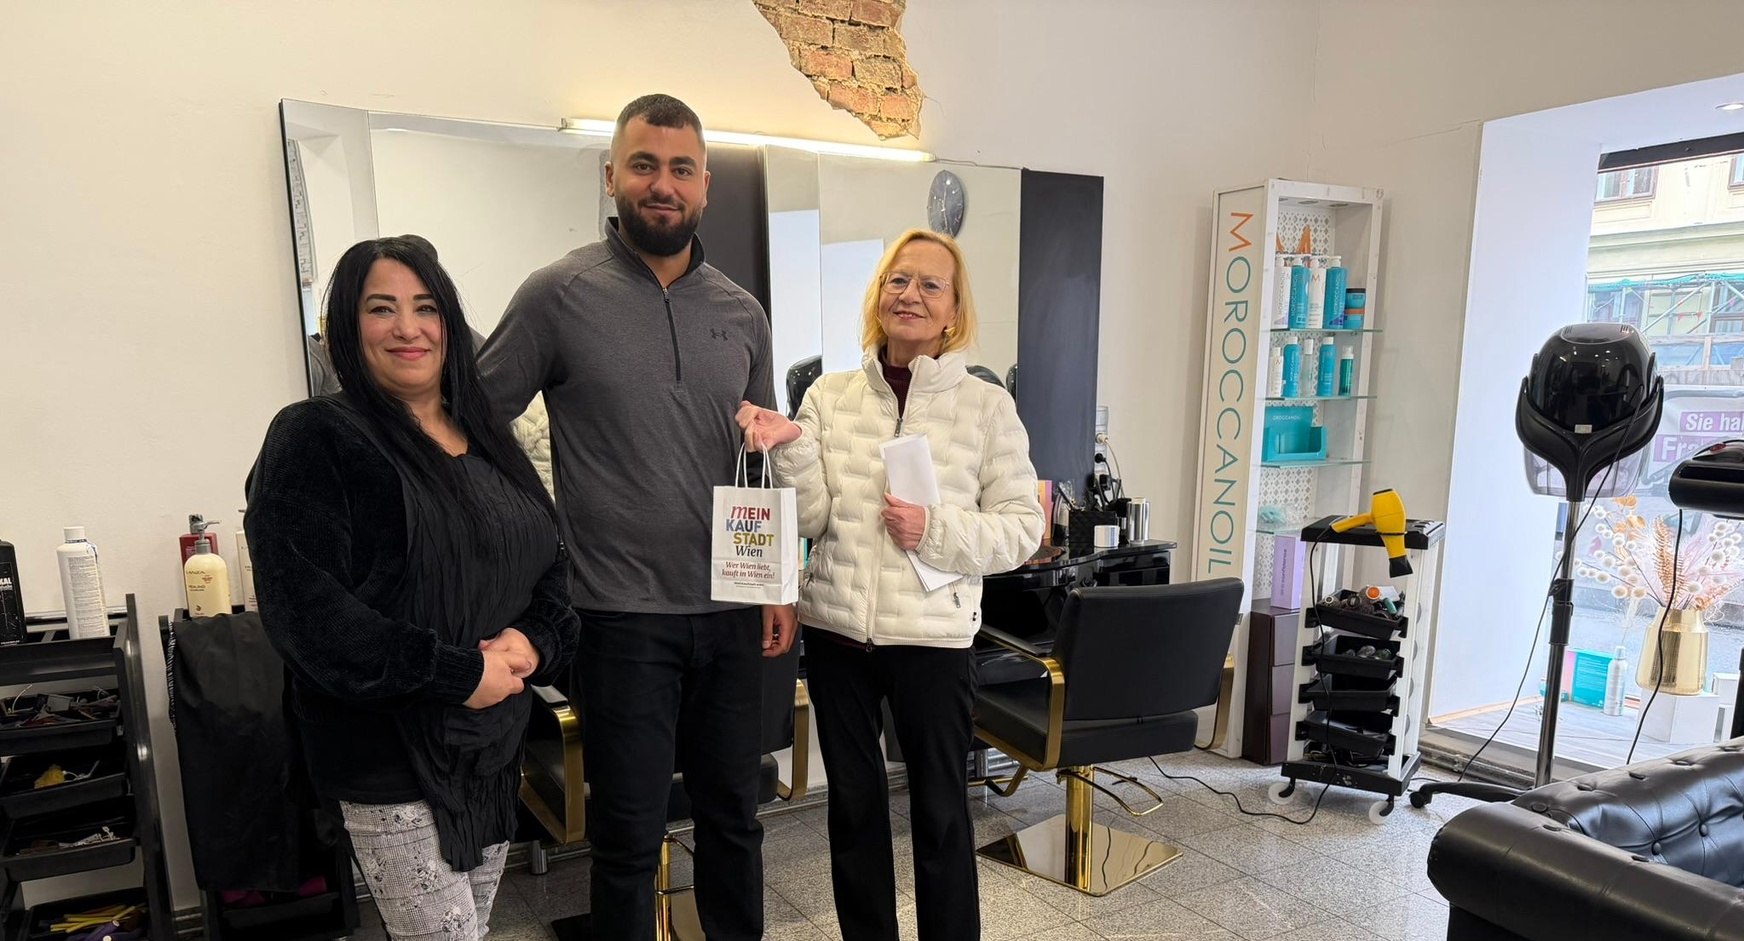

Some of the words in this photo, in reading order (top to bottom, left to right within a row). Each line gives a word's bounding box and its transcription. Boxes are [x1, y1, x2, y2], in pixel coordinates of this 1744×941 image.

[1207, 211, 1255, 574] MOROCCANOIL
[1685, 413, 1713, 431] Sie
[726, 519, 762, 532] KAUF
[733, 532, 774, 546] STADT
[735, 545, 763, 557] Wien
[722, 569, 739, 578] kauft
[747, 570, 763, 578] Wien
[757, 563, 771, 572] liebt,
